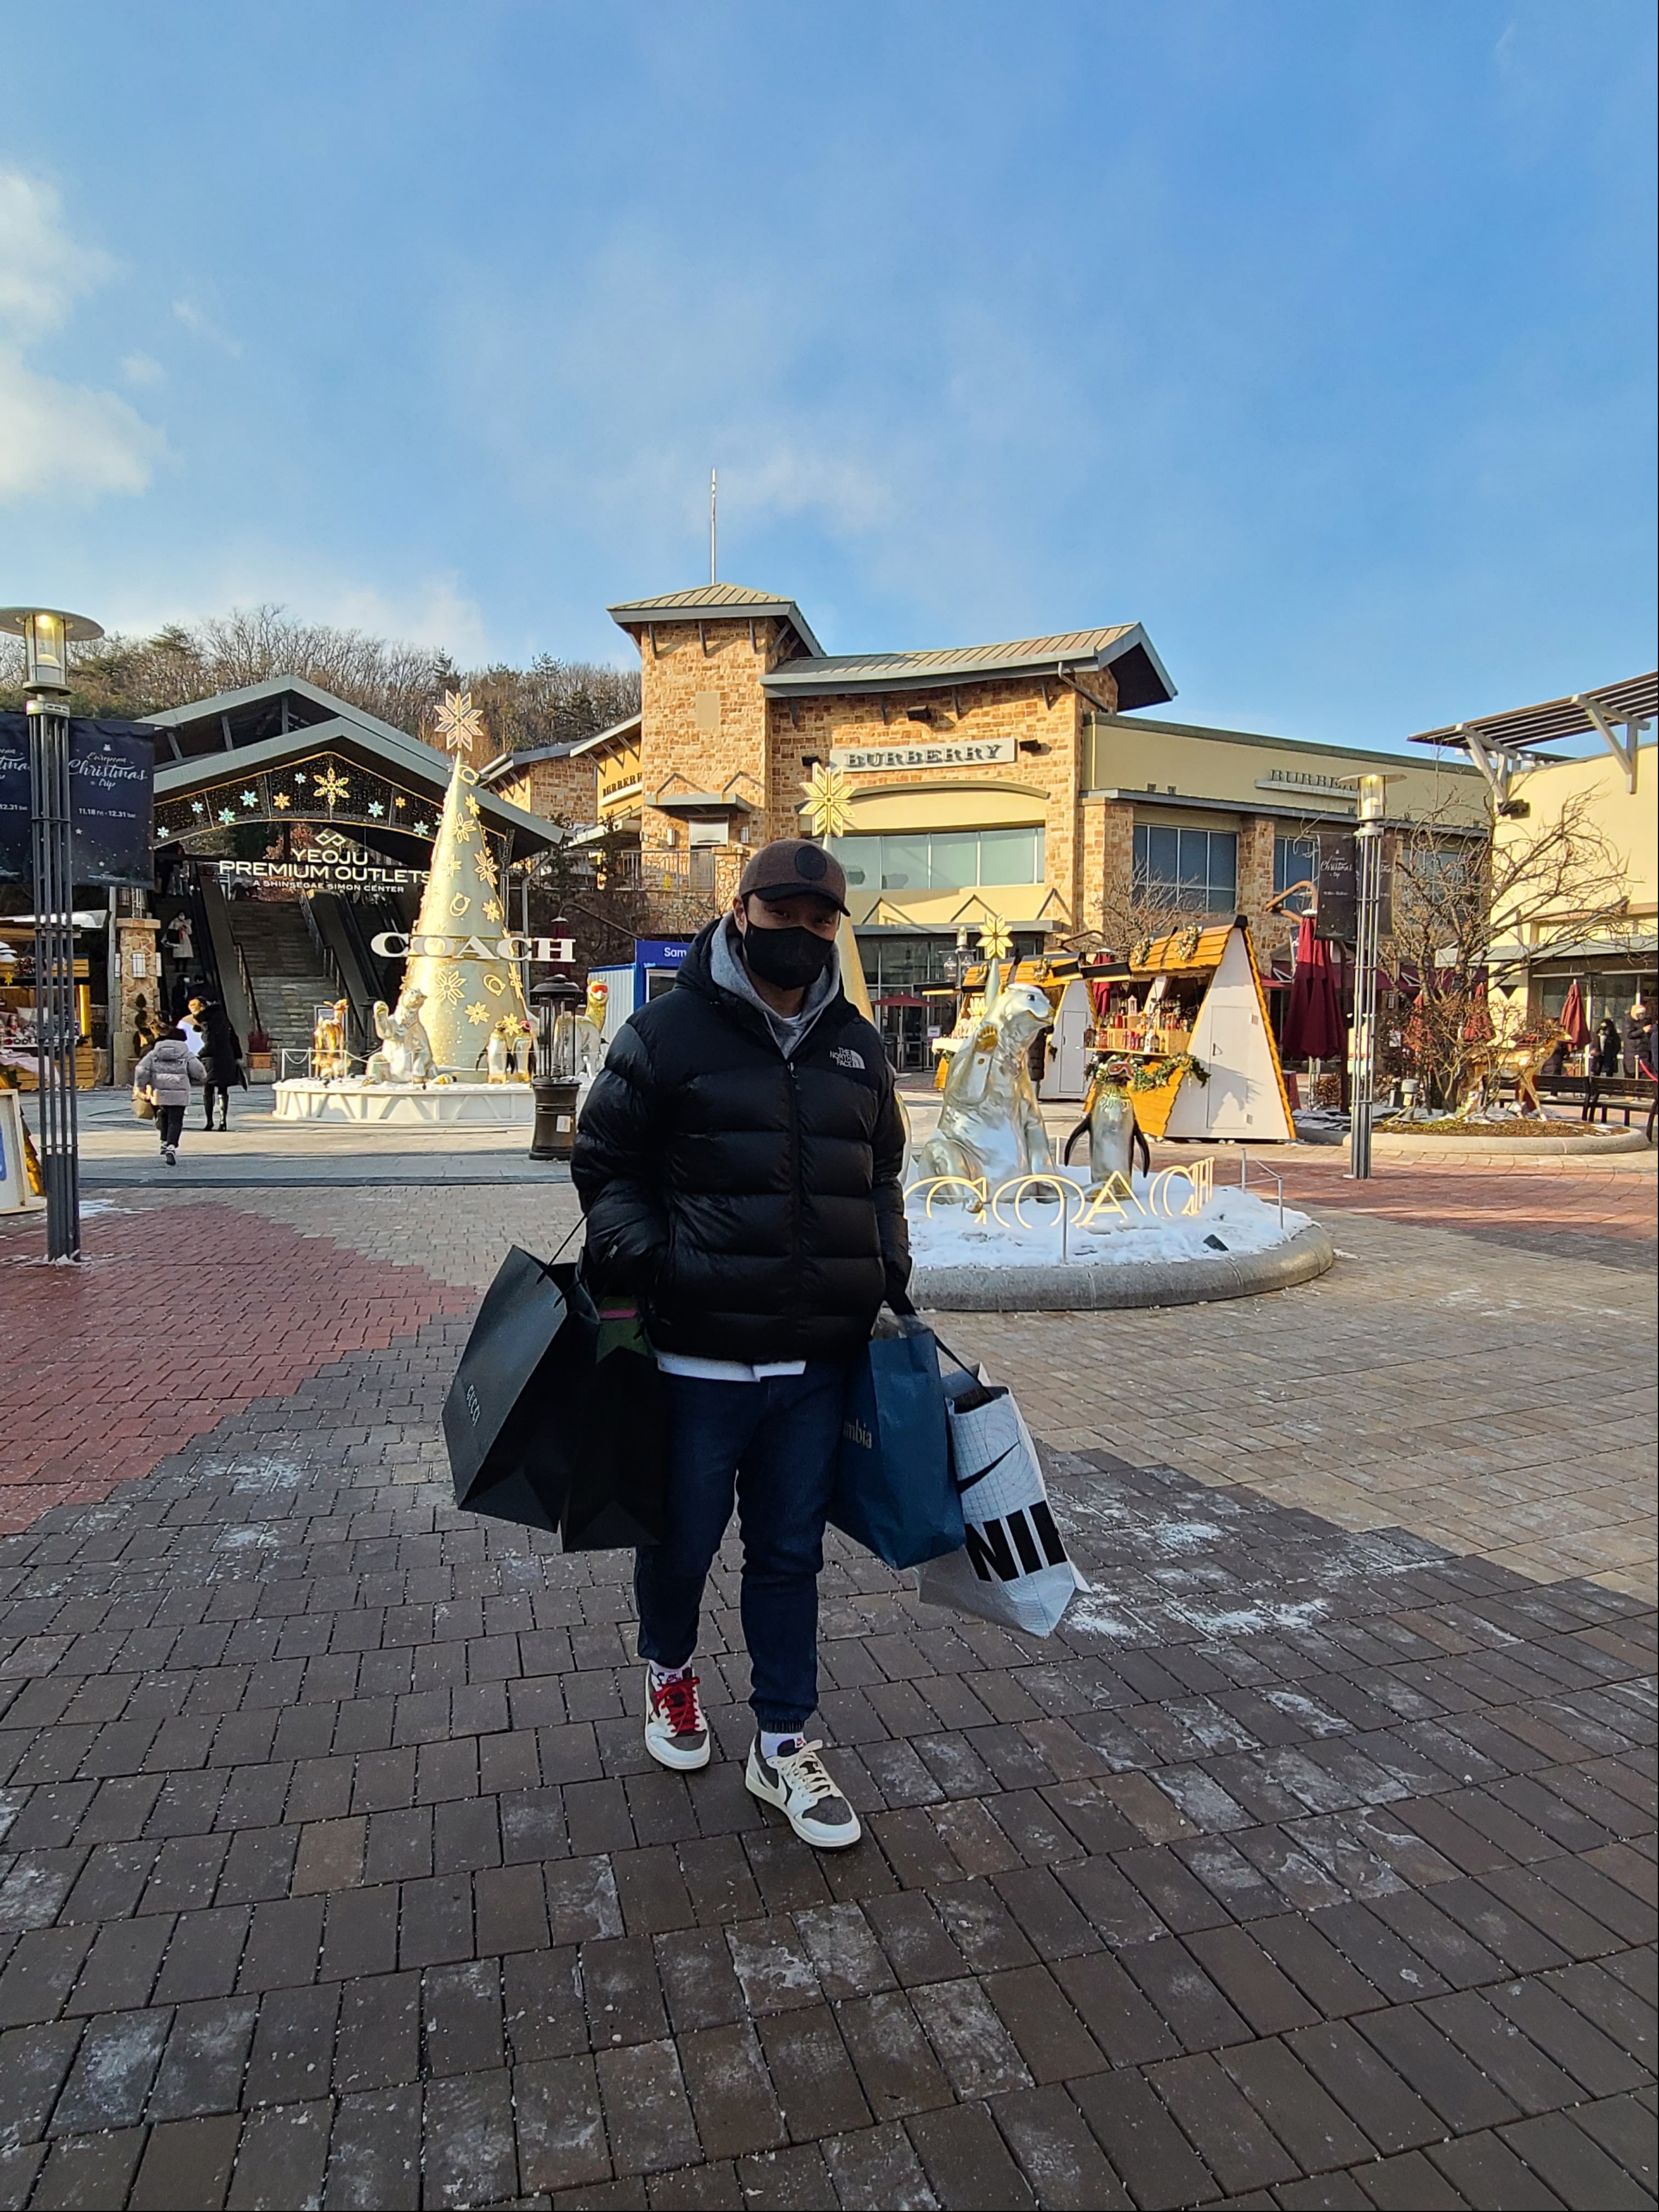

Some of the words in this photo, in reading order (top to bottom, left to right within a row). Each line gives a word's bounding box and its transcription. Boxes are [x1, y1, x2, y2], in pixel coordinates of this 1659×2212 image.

[844, 745, 1003, 768] BURBERRY
[68, 759, 148, 780] Christmas
[291, 848, 368, 865] YEOJU
[219, 860, 329, 879] PREMIUM
[263, 880, 325, 889] SHINSEGAE
[371, 932, 576, 962] COACH
[664, 947, 686, 957] Sam
[829, 1050, 851, 1063] NORTH
[837, 1046, 850, 1056] THE
[836, 1058, 852, 1068] FACE
[903, 1156, 1215, 1229] COACH
